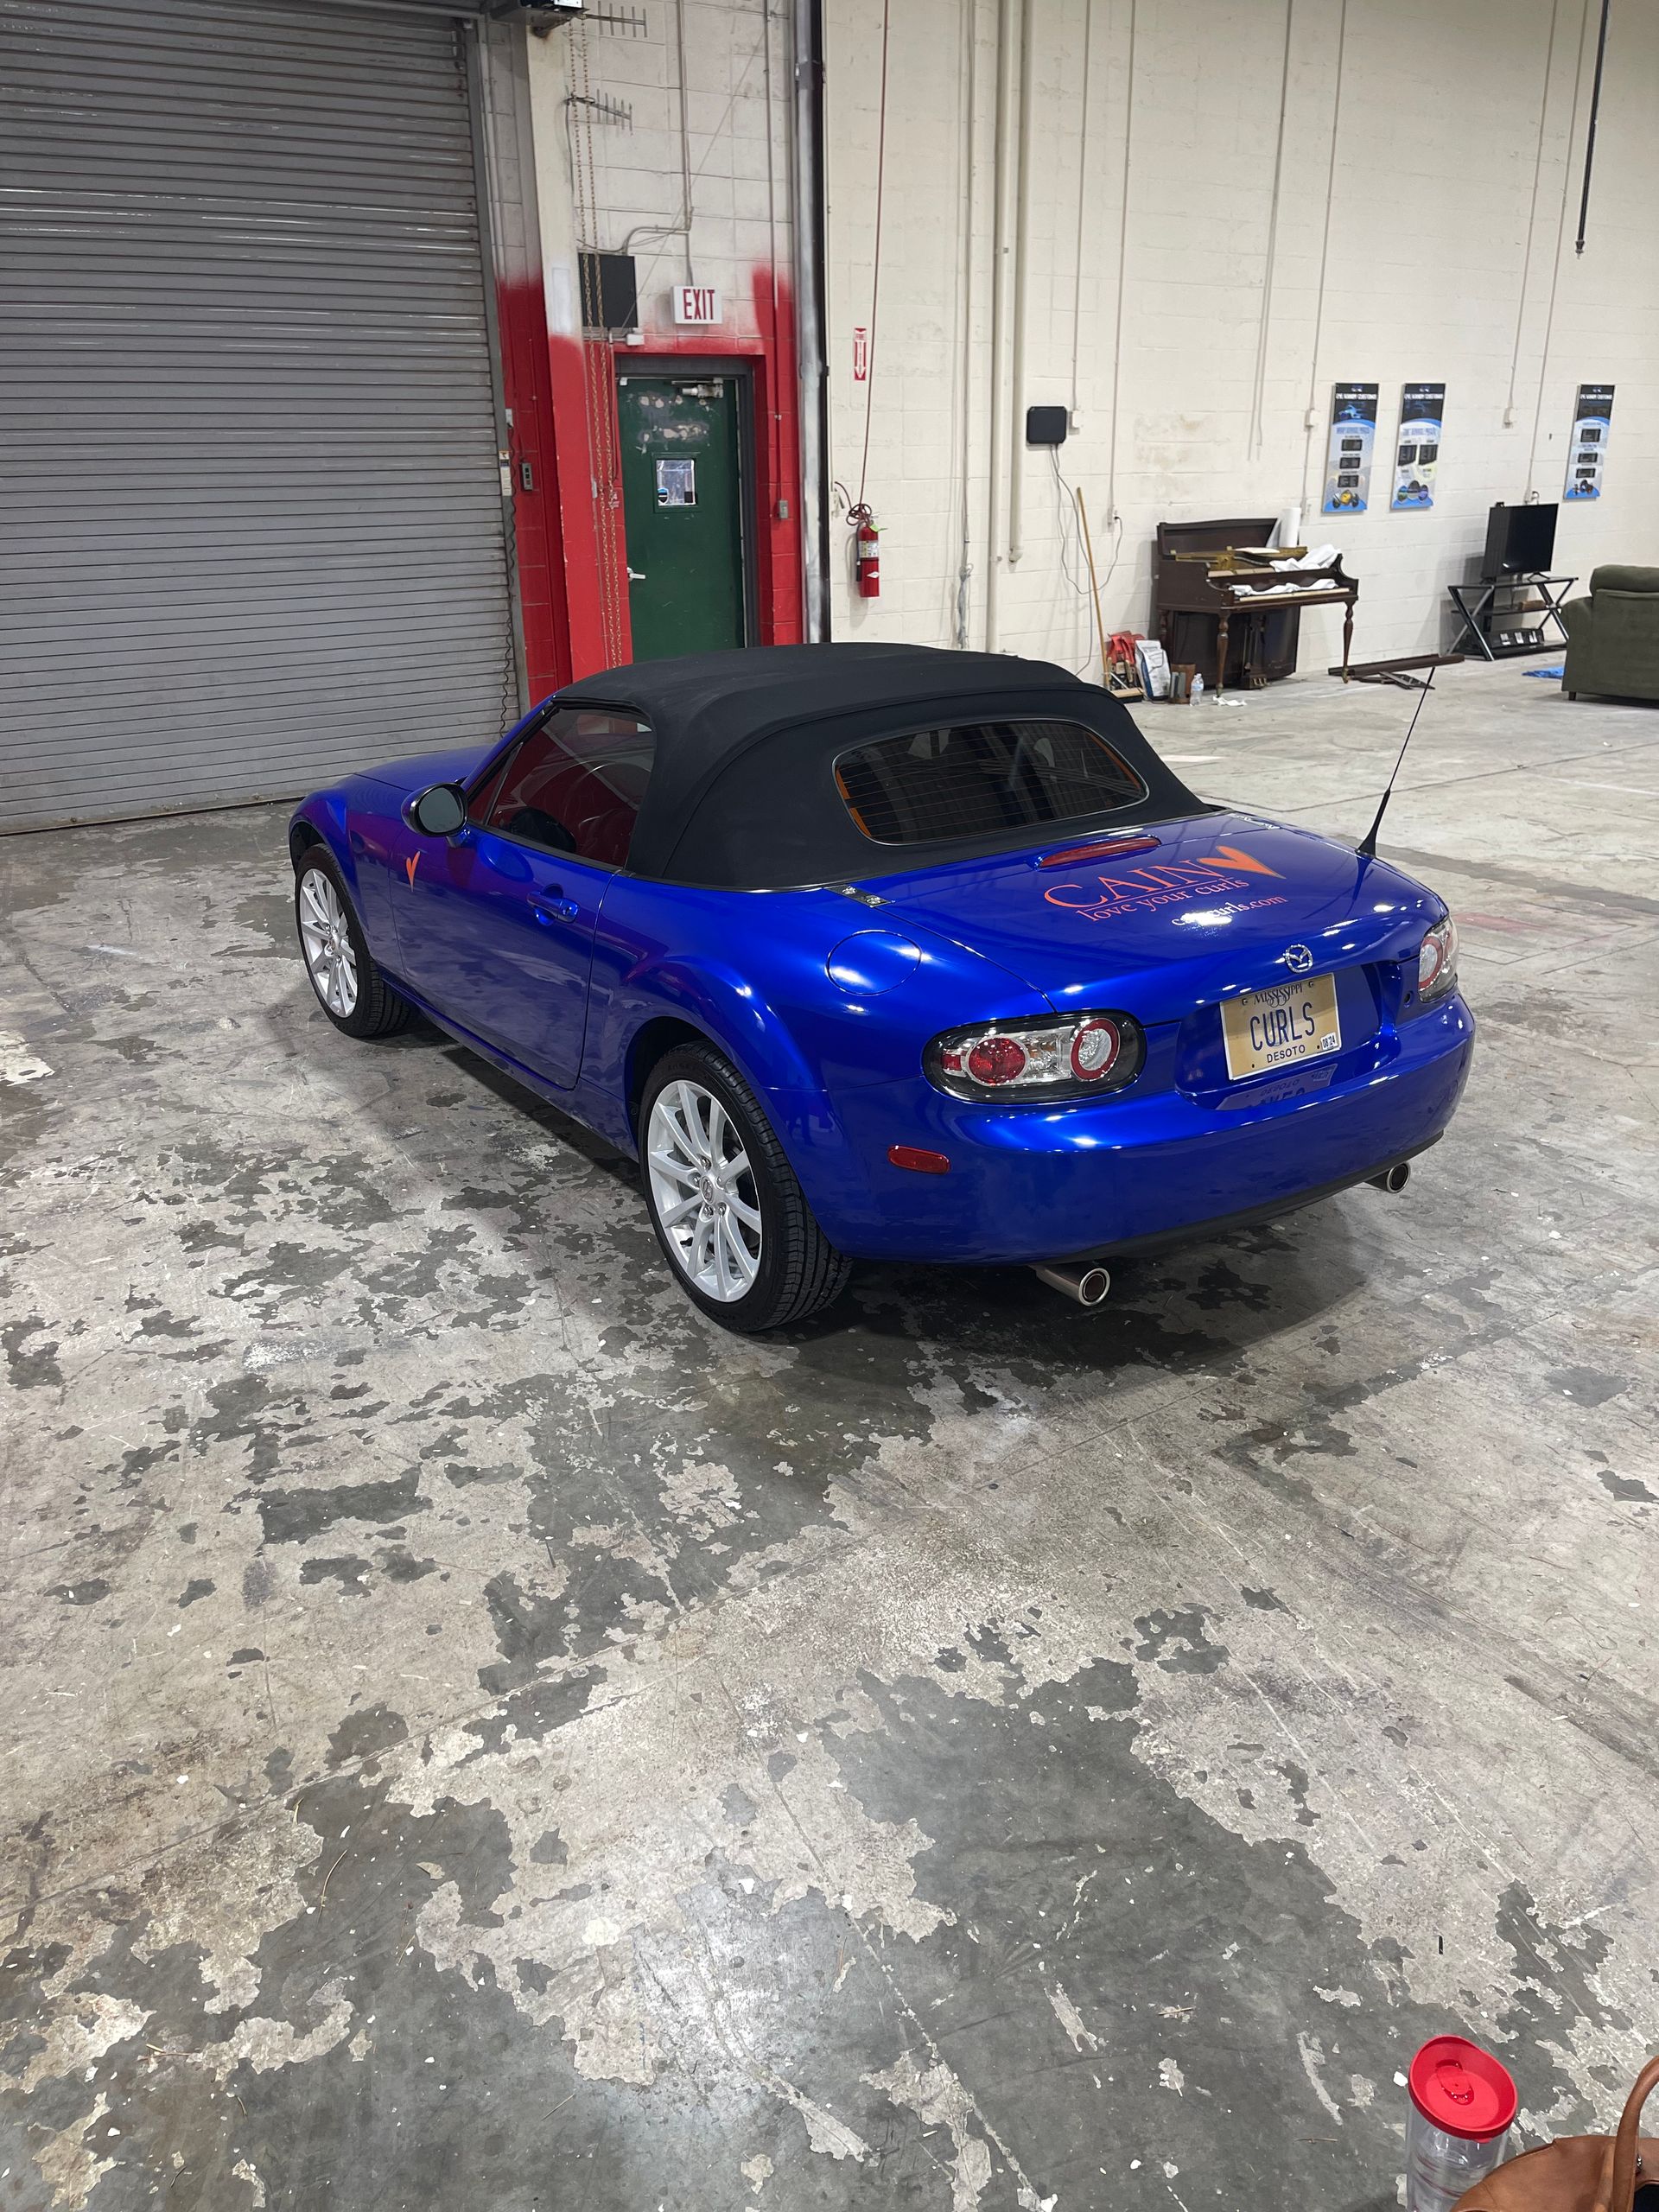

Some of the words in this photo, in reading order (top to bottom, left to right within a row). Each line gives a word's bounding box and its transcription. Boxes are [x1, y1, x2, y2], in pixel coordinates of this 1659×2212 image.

[683, 289, 715, 320] EXIT
[1044, 859, 1225, 908] CAIN
[1075, 904, 1138, 922] love
[1135, 891, 1193, 912] your
[1195, 876, 1249, 895] curls
[1171, 896, 1288, 925] ccurls.com
[1253, 982, 1303, 1009] MISSISSIPPI
[1250, 1002, 1315, 1051] CURLS
[1267, 1044, 1306, 1064] DESOTO
